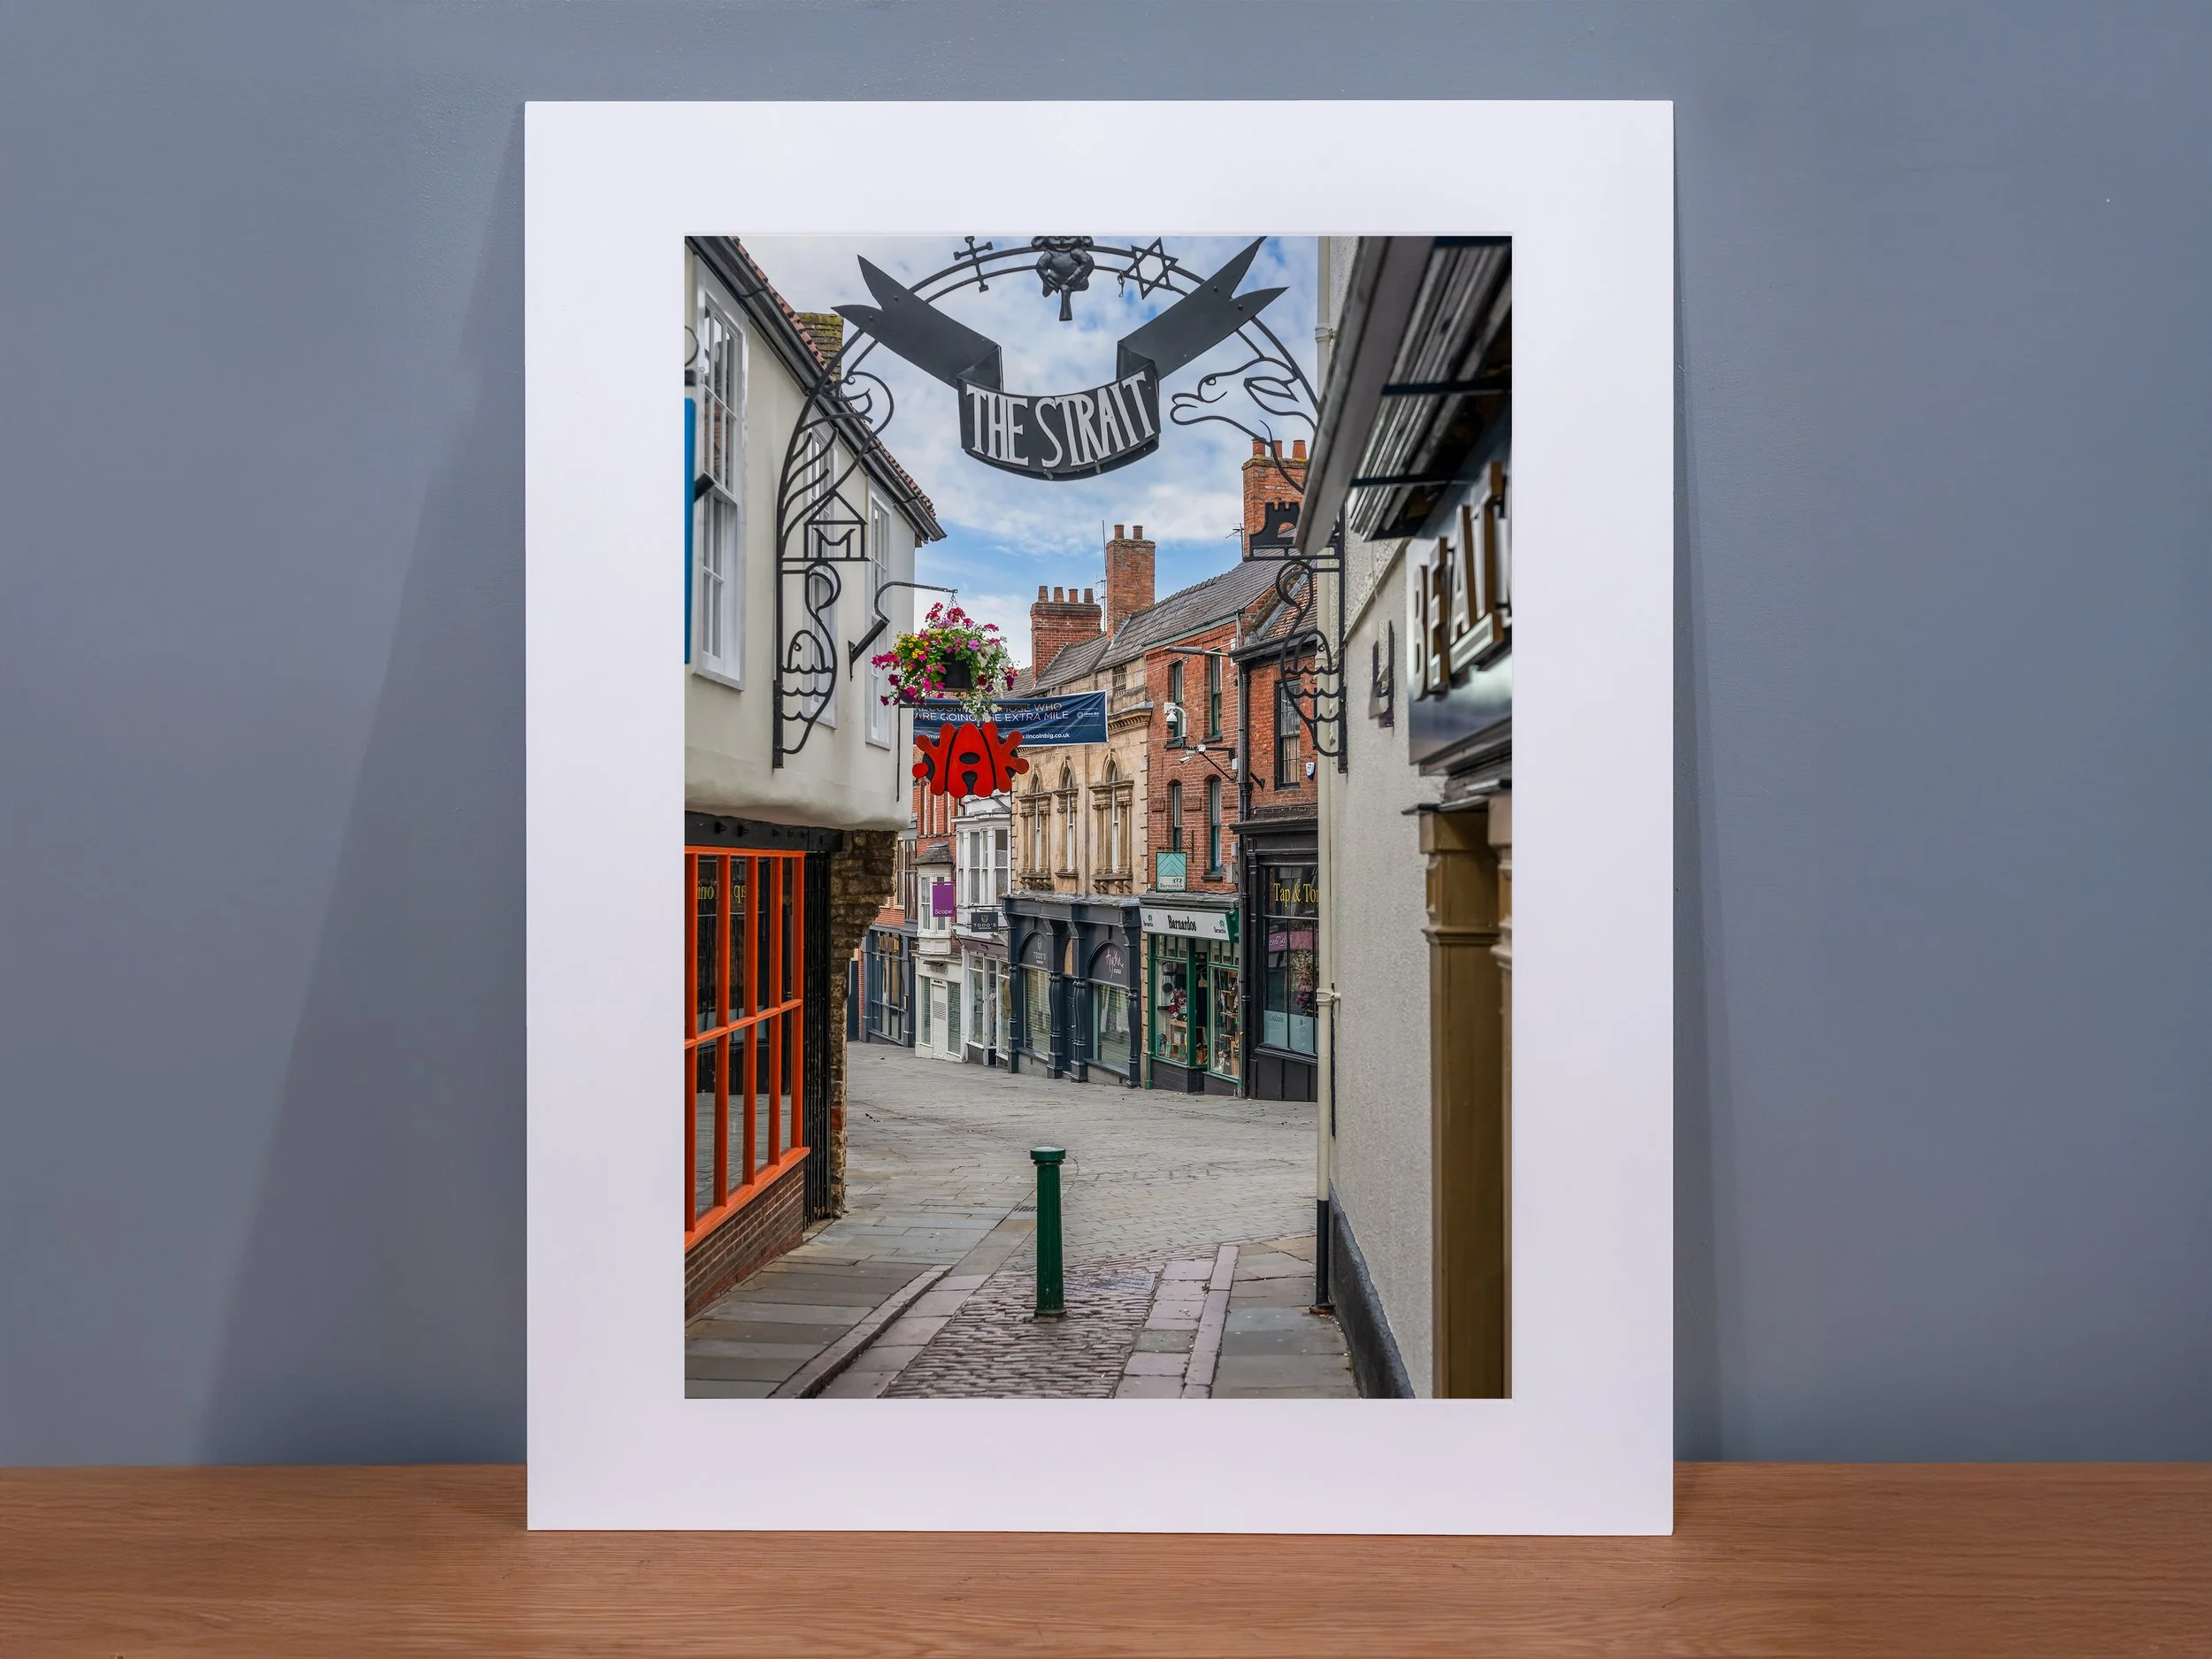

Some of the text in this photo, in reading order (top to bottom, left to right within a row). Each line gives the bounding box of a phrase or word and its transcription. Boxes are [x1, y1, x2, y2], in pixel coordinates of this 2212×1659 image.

[966, 371, 1155, 468] THE STRAIT
[913, 710, 1069, 722] ARE GOING HE EXTRA MILE
[1033, 703, 1063, 711] WHO
[1273, 882, 1291, 908] Tap
[1293, 883, 1301, 902] &
